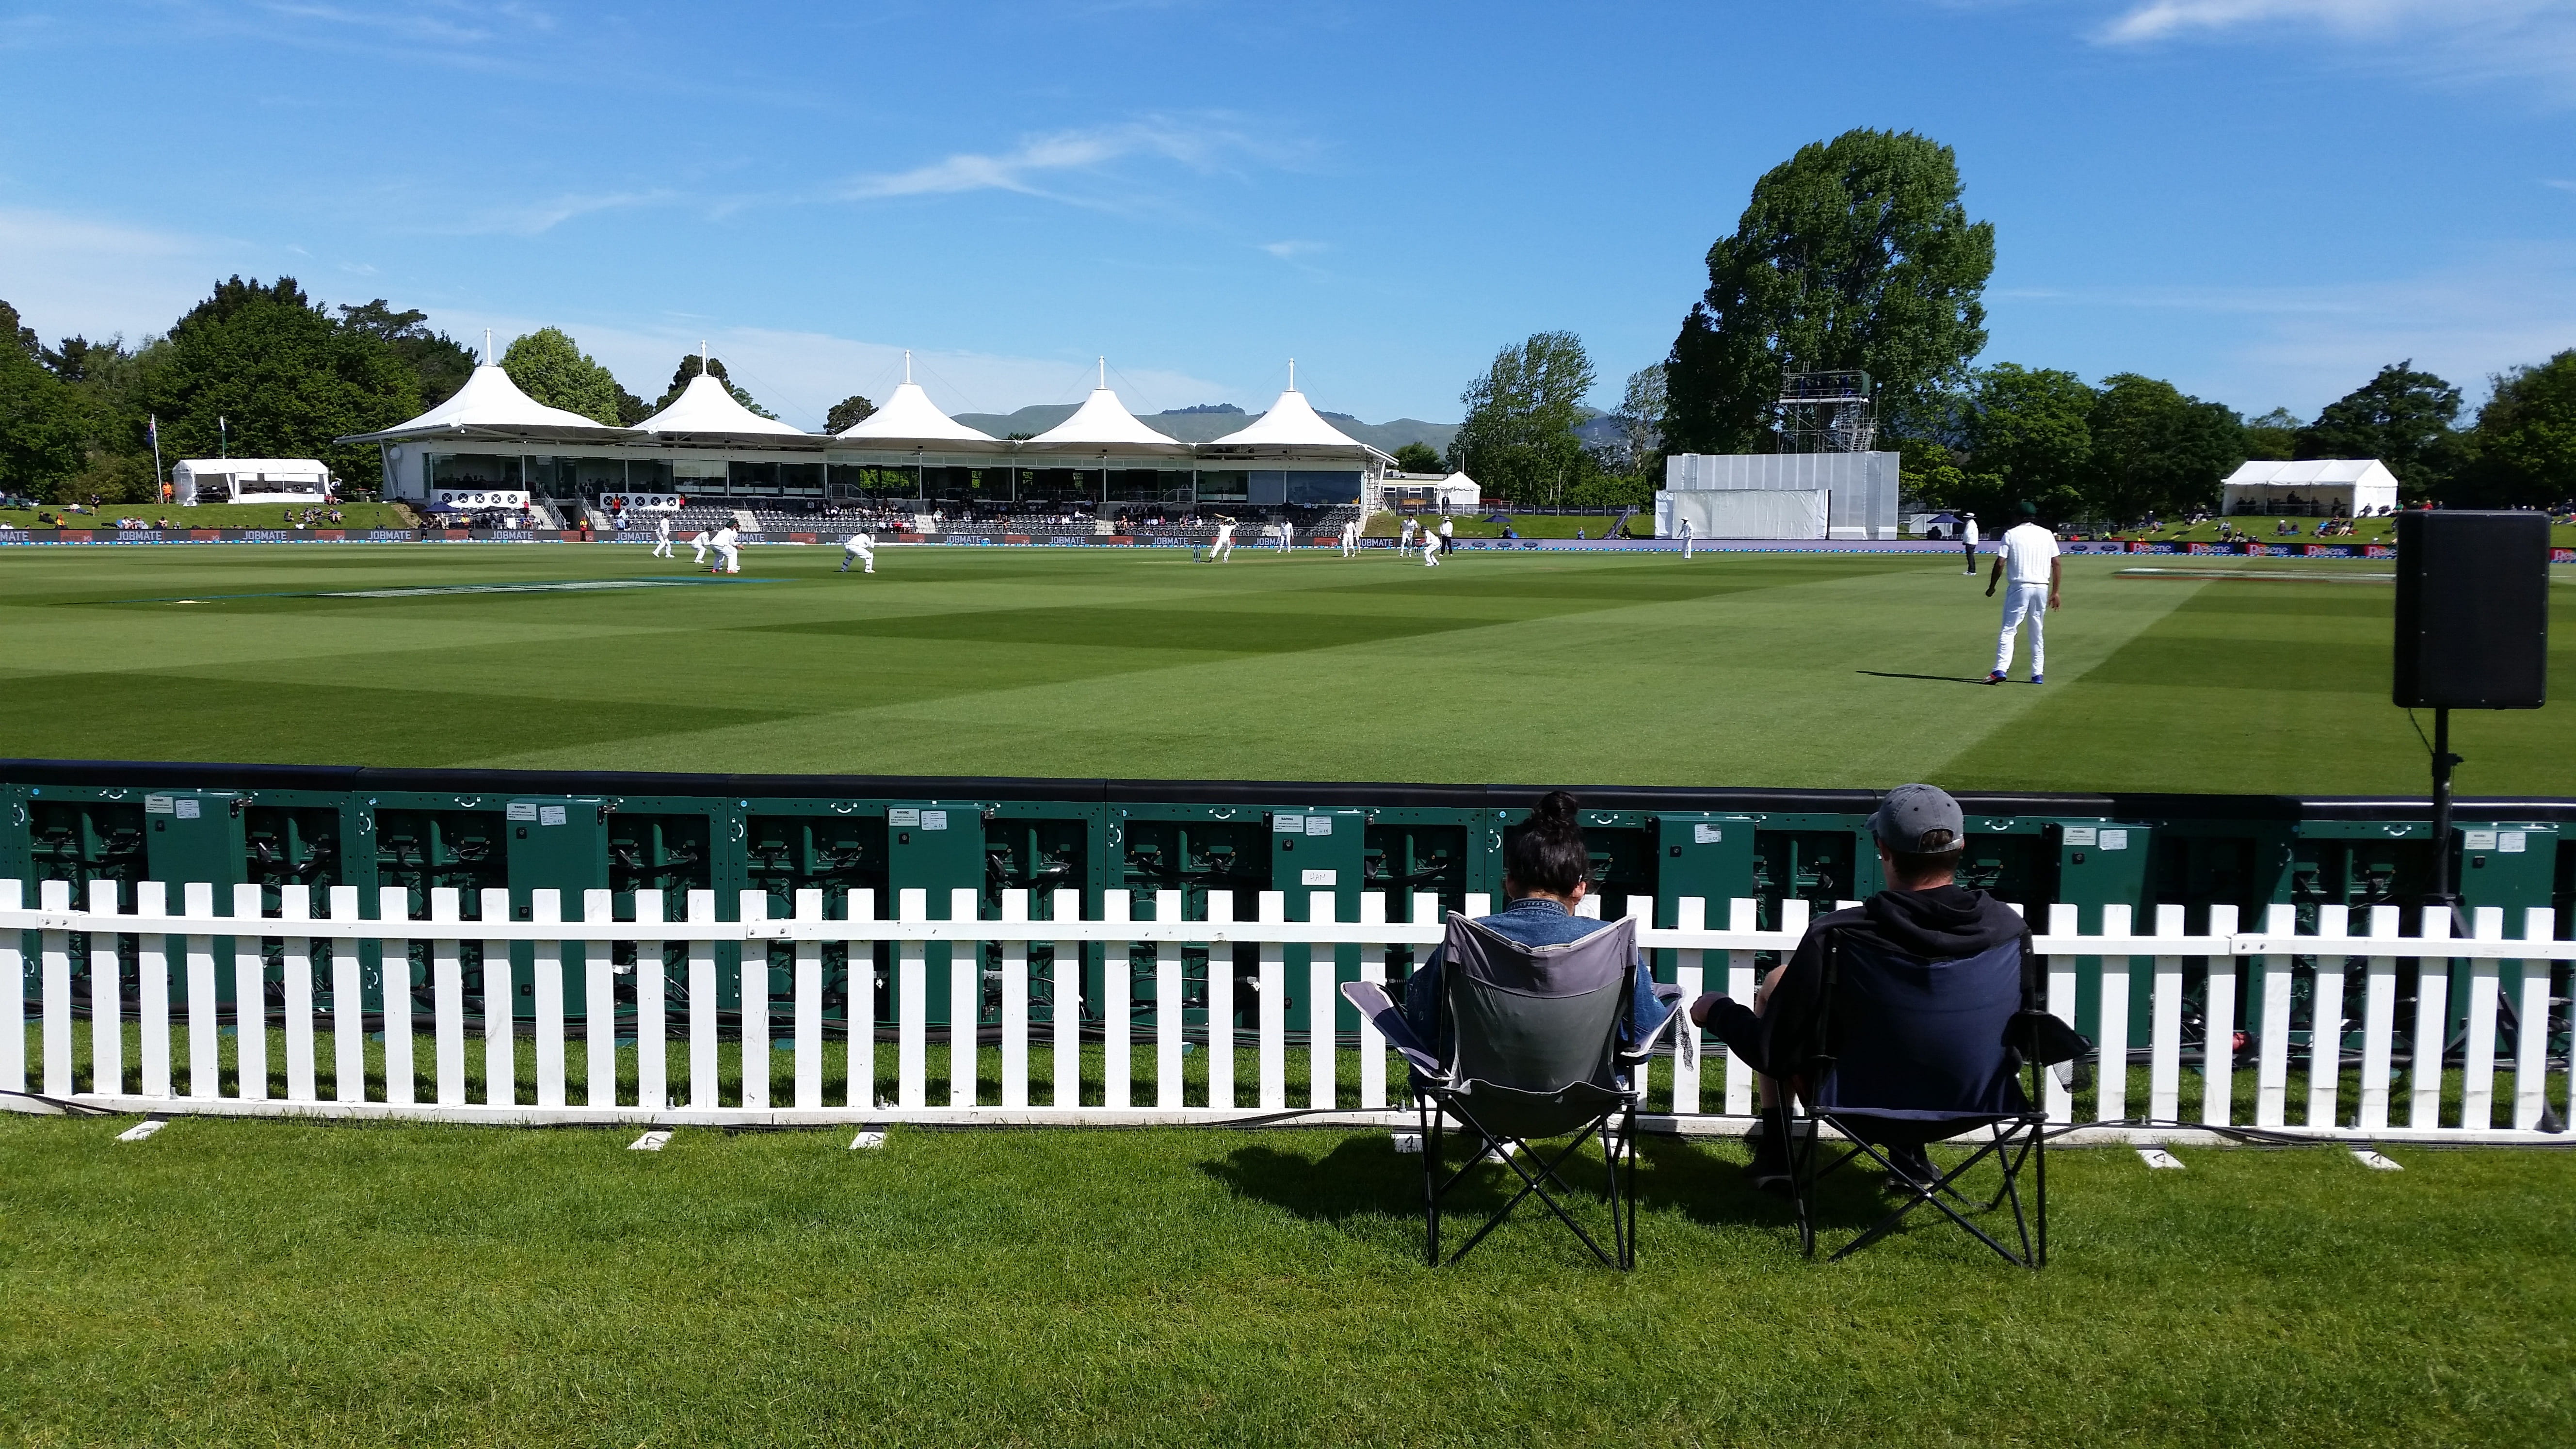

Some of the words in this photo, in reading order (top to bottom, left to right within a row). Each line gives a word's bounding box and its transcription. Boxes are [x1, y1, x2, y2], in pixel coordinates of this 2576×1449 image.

[0, 531, 29, 541] MATE
[116, 531, 162, 541] JOBMATE
[242, 531, 287, 540] JOBMATE
[368, 531, 411, 540] JOBMATE
[491, 531, 534, 540] JOBMATE
[736, 533, 765, 542] BMATE
[944, 535, 982, 543] JOBMATE
[2133, 543, 2172, 552] Resene
[2192, 544, 2230, 553] Resene
[2250, 545, 2288, 554] Resene
[2308, 547, 2348, 556] Resene
[2368, 547, 2397, 556] Rese
[2555, 550, 2576, 561] Res
